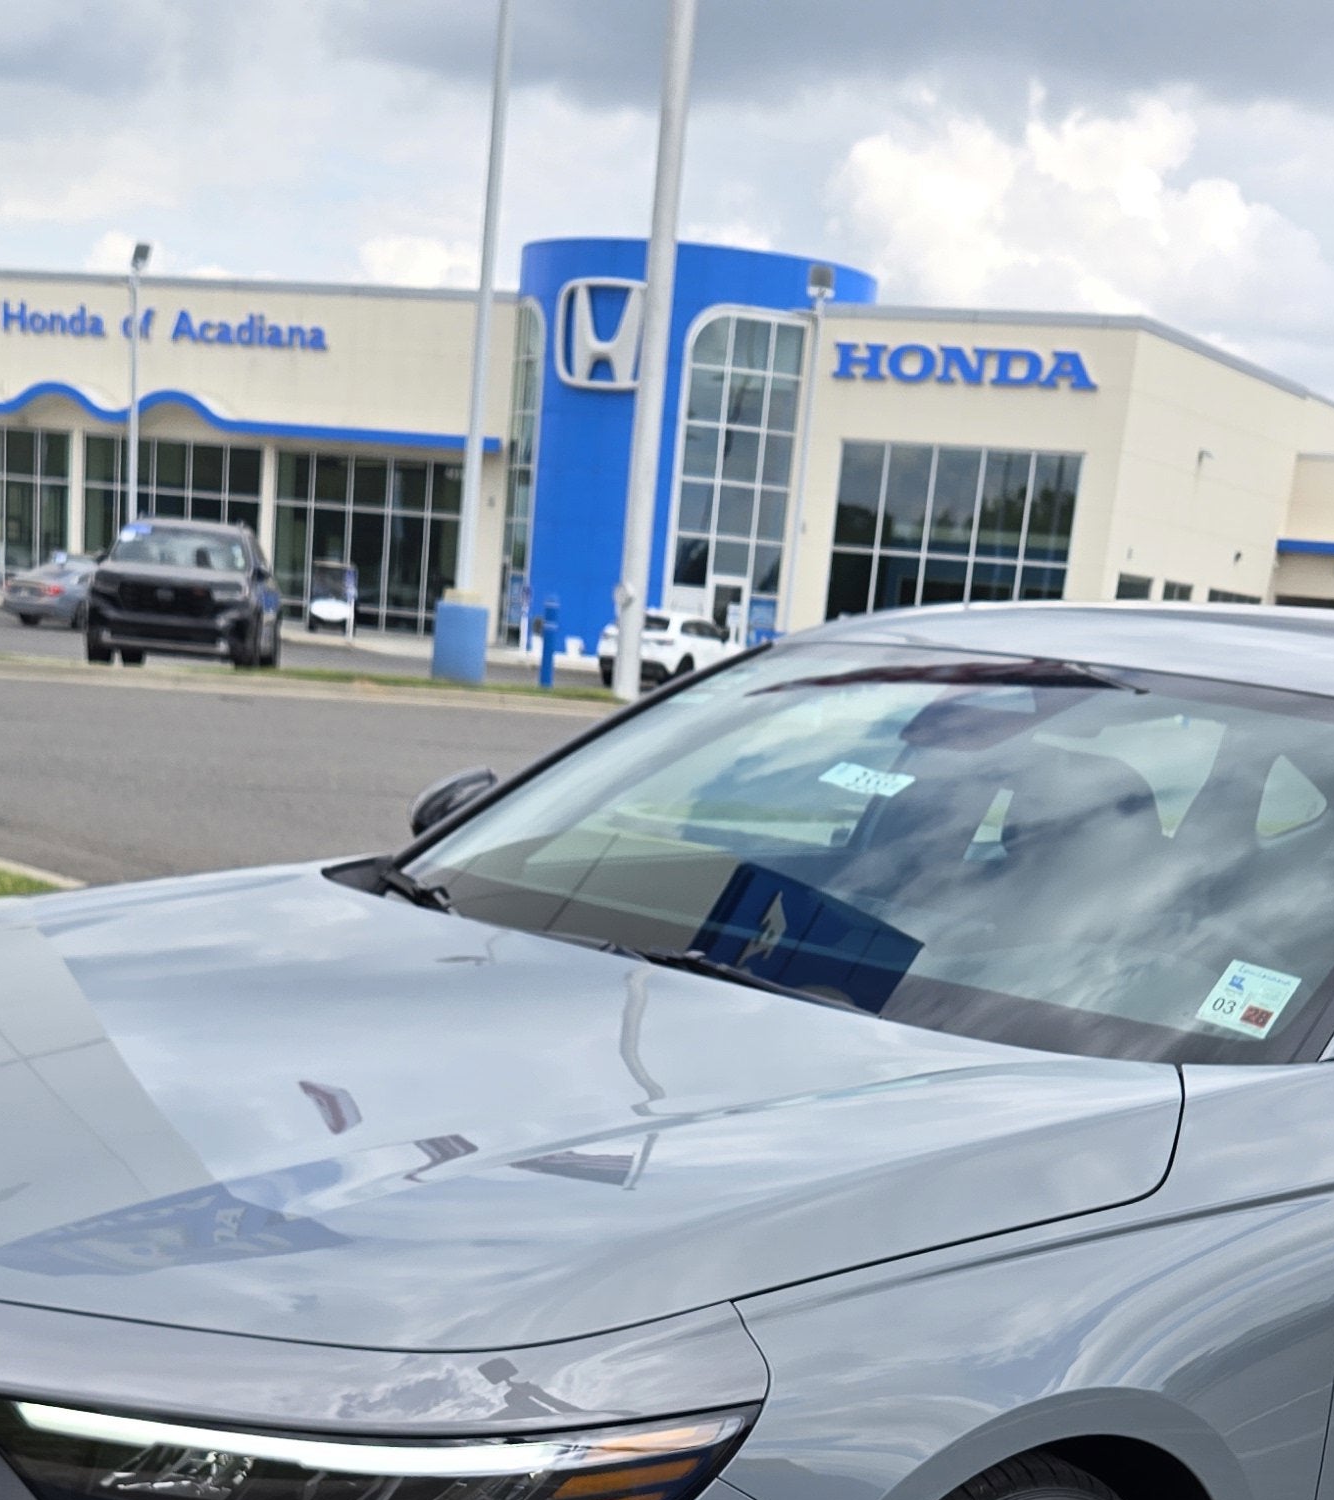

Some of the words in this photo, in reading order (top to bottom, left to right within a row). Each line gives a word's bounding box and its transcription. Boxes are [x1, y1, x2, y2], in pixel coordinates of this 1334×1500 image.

[2, 299, 105, 337] Honda
[171, 309, 328, 351] Acadiana
[832, 342, 1098, 391] HONDA
[1212, 997, 1237, 1015] 03
